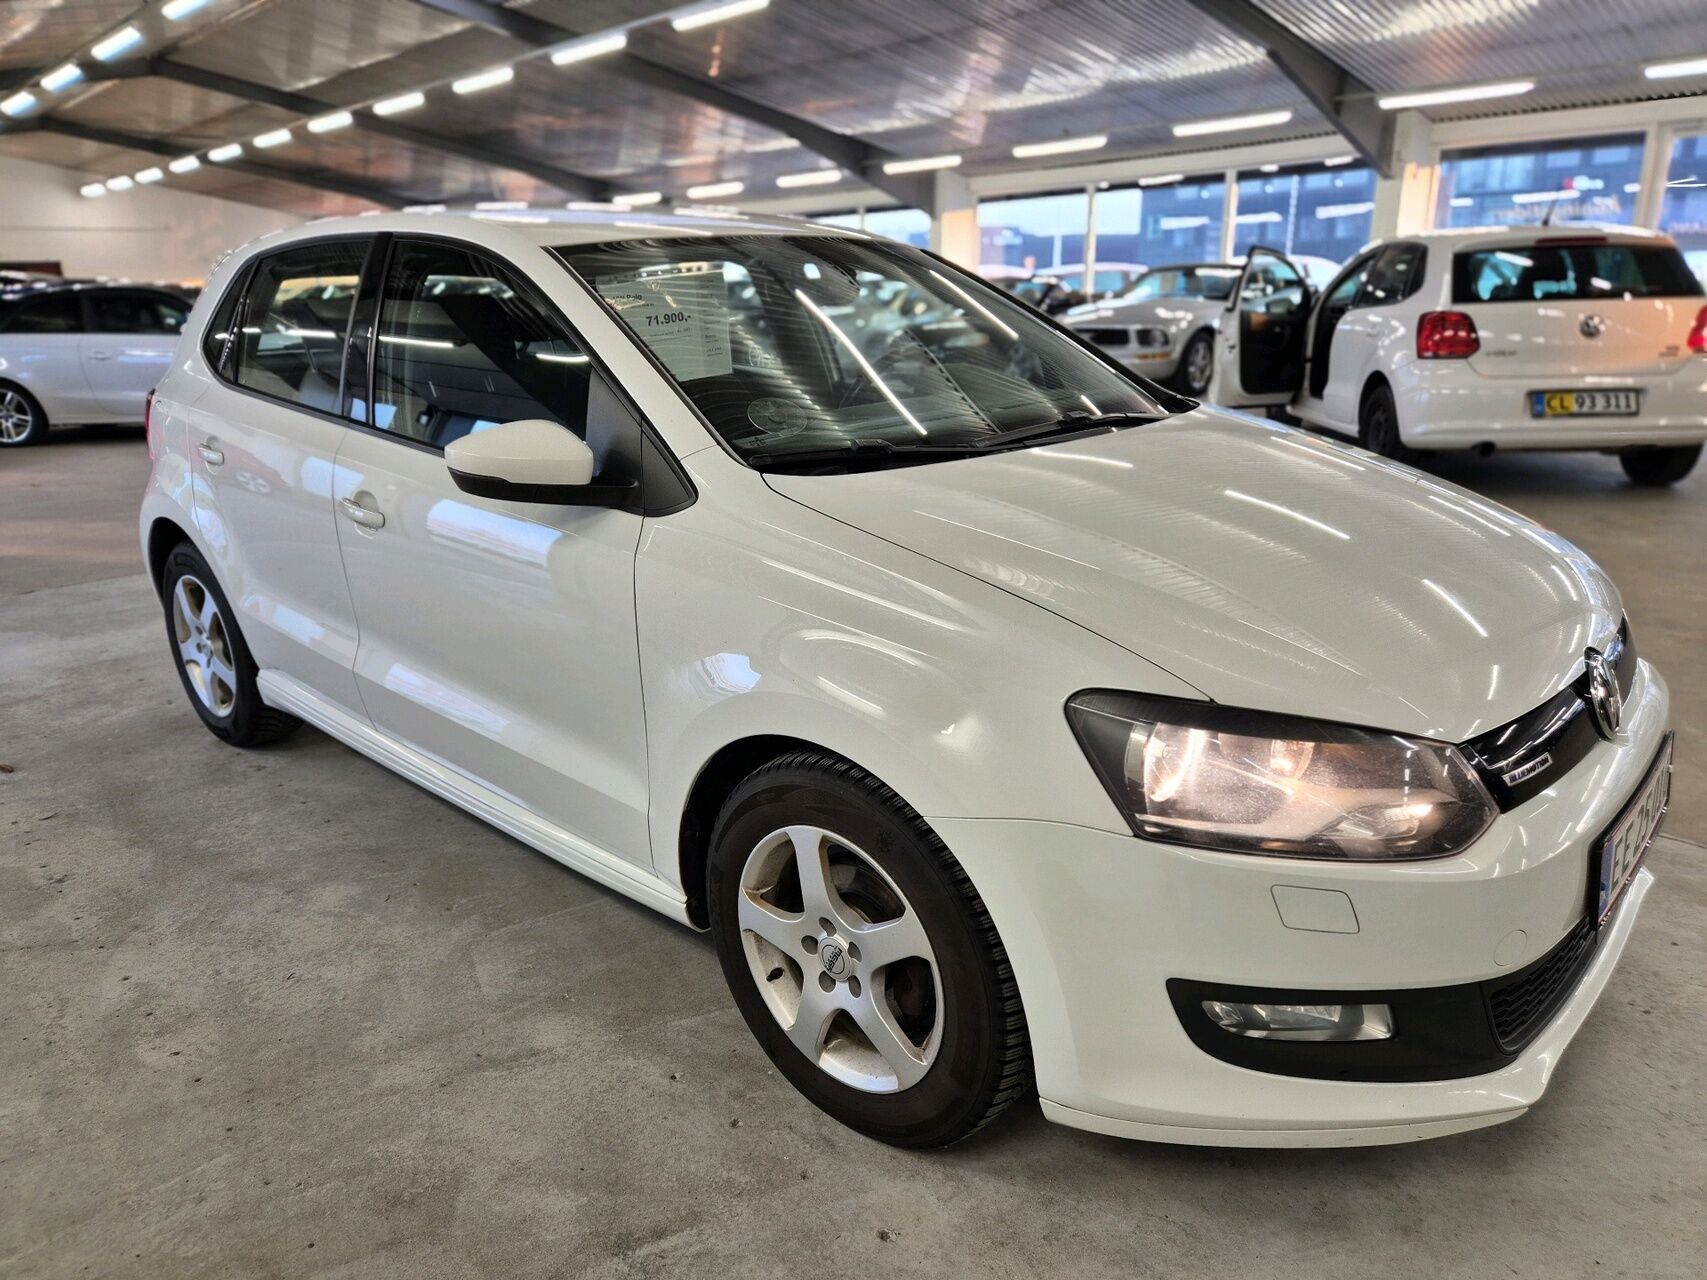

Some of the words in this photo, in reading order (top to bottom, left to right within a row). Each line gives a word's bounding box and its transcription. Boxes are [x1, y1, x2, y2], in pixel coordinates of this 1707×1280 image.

[645, 311, 692, 327] 71.900,-
[1546, 394, 1568, 412] CL
[1576, 393, 1597, 410] 93
[1602, 393, 1632, 410] 311
[1611, 820, 1634, 893] EE
[1633, 787, 1654, 858] 25
